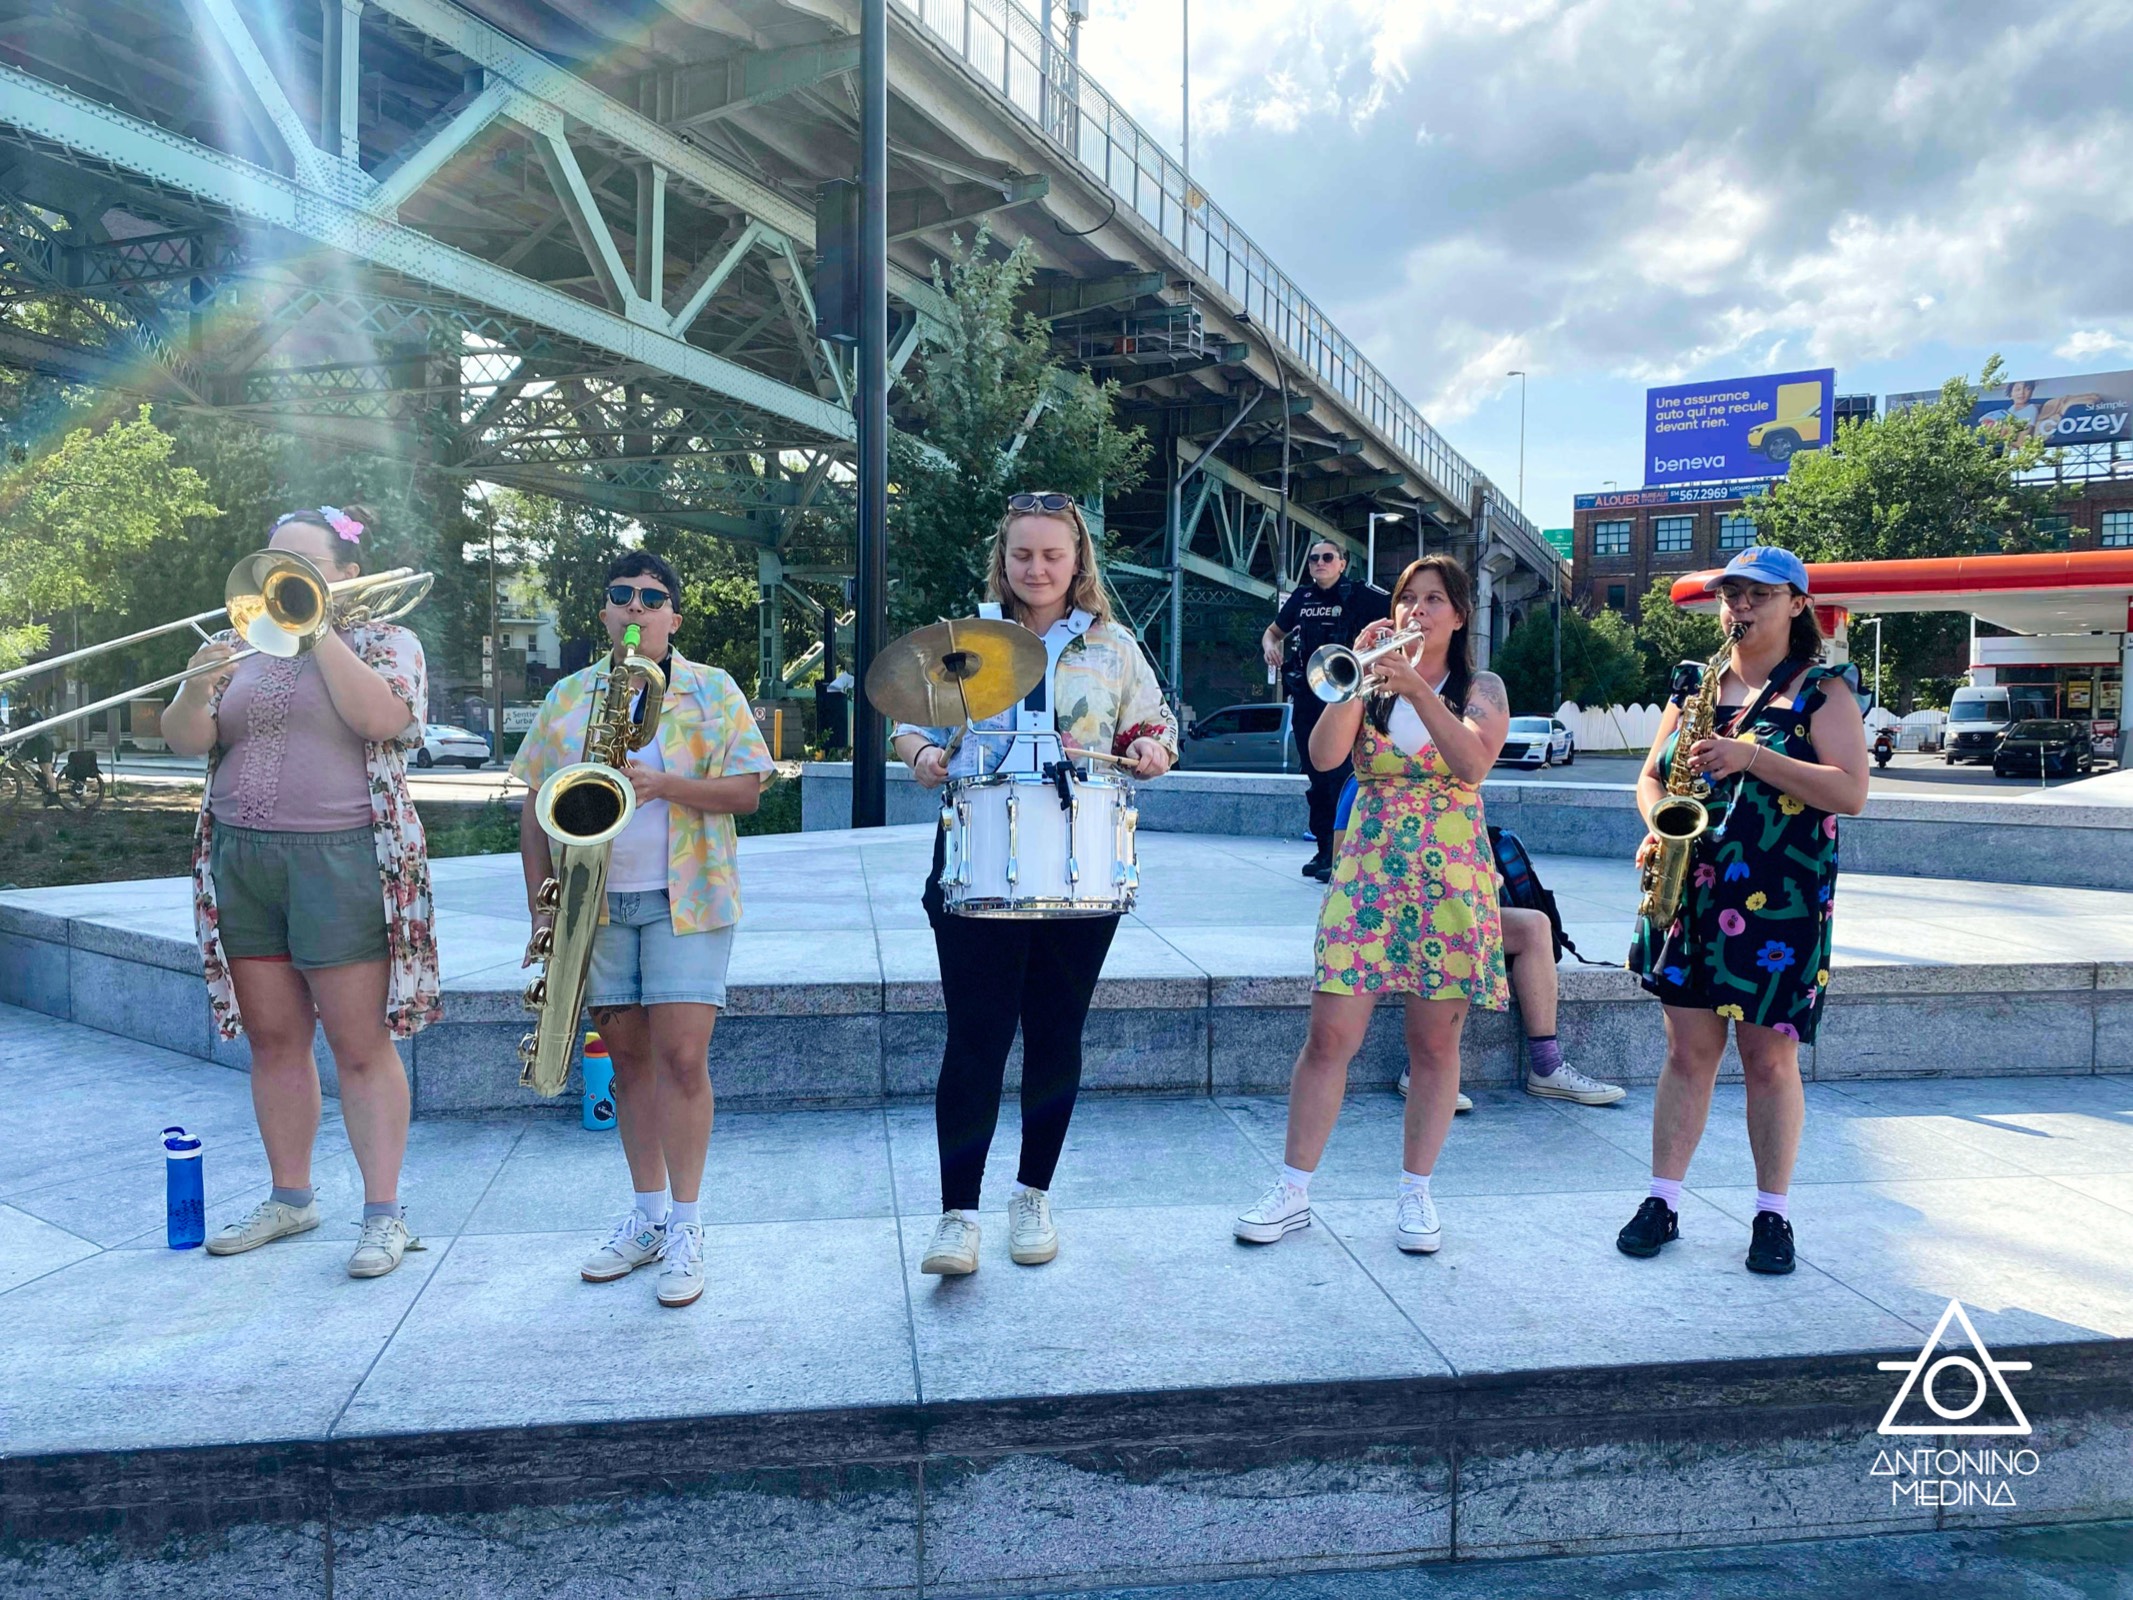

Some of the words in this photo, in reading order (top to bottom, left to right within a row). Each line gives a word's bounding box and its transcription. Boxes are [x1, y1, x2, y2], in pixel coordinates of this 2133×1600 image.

[1656, 397, 1681, 409] Une
[1683, 391, 1750, 406] assurance
[1655, 409, 1684, 421] auto
[1687, 405, 1707, 419] qui
[1709, 406, 1725, 416] ne
[1728, 400, 1769, 414] recule
[1655, 419, 1698, 433] devant
[1701, 416, 1730, 429] rien.
[2039, 412, 2129, 435] cozey
[1654, 455, 1726, 473] beneva
[1680, 487, 1728, 501] 567.2969
[1299, 606, 1332, 617] POLICE
[512, 710, 537, 719] Sentie
